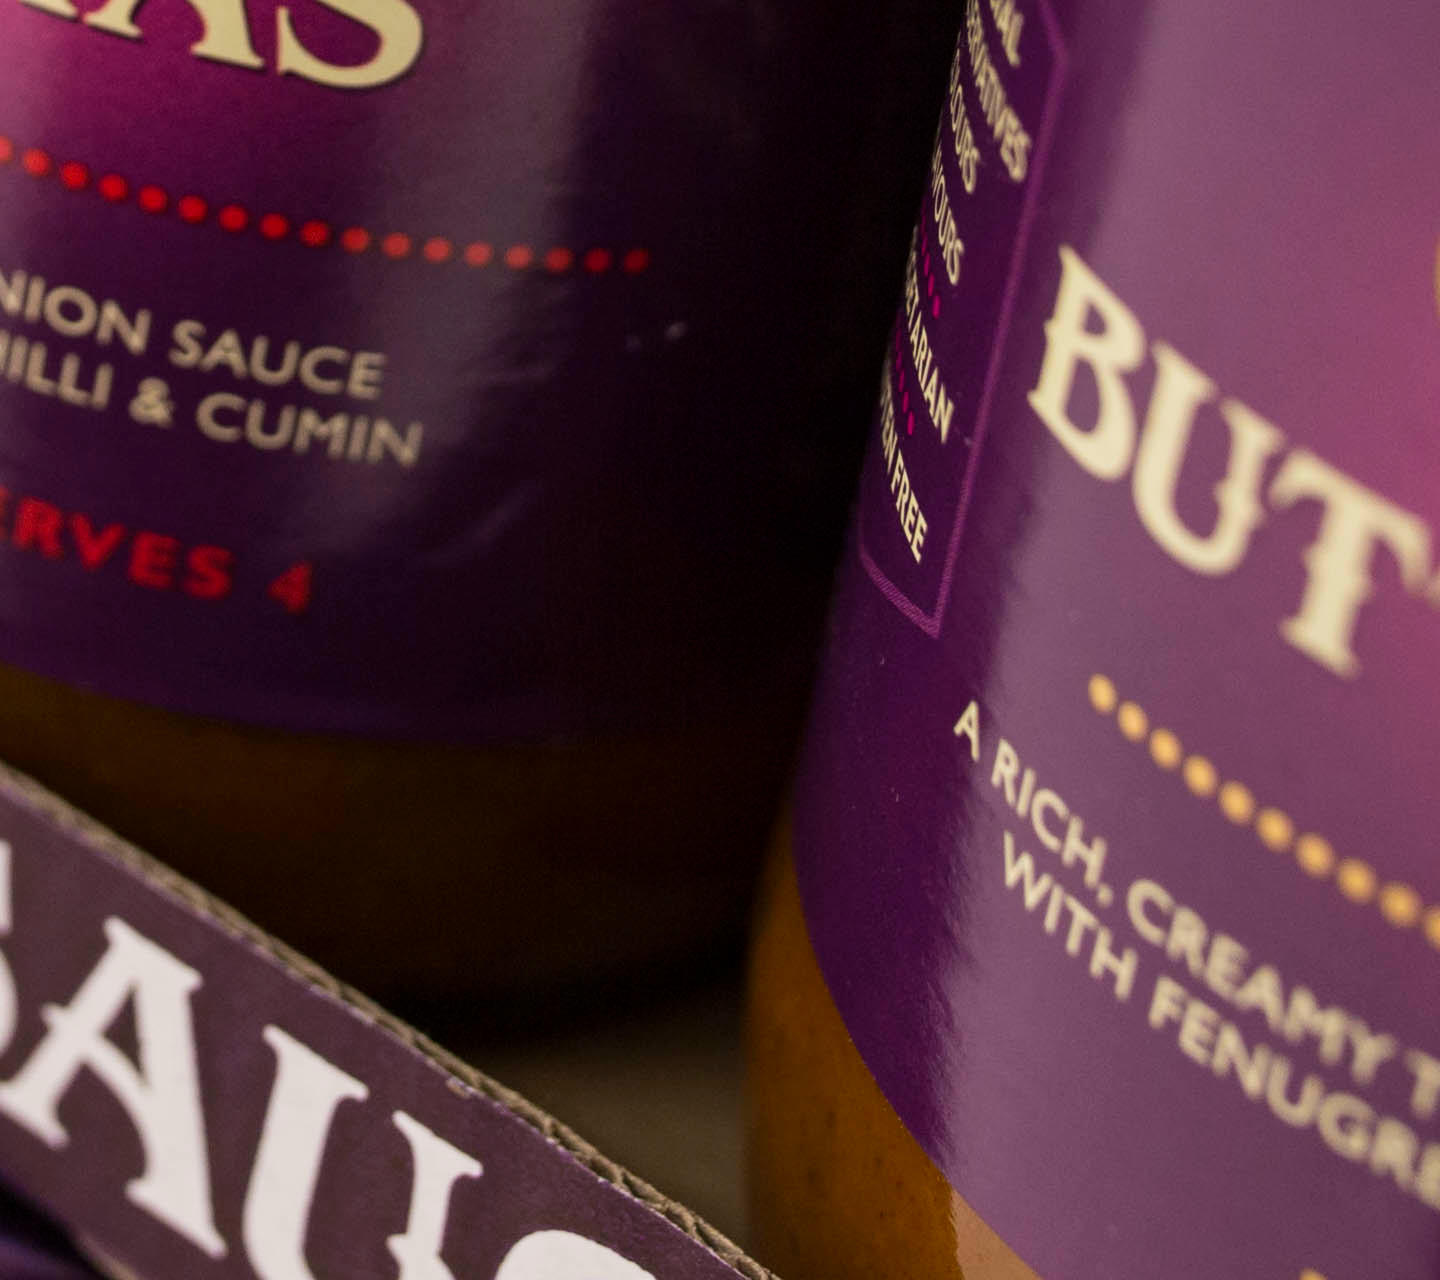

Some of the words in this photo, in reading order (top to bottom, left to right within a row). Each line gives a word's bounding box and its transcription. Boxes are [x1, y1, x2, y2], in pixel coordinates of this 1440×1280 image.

[169, 319, 388, 400] SAUCE
[128, 377, 175, 429] &
[196, 391, 423, 468] CUMIN
[890, 447, 928, 565] FREE
[267, 561, 313, 616] 4
[953, 699, 981, 762] A
[1125, 877, 1398, 1085] CREAMY
[1003, 829, 1139, 1003] WITH
